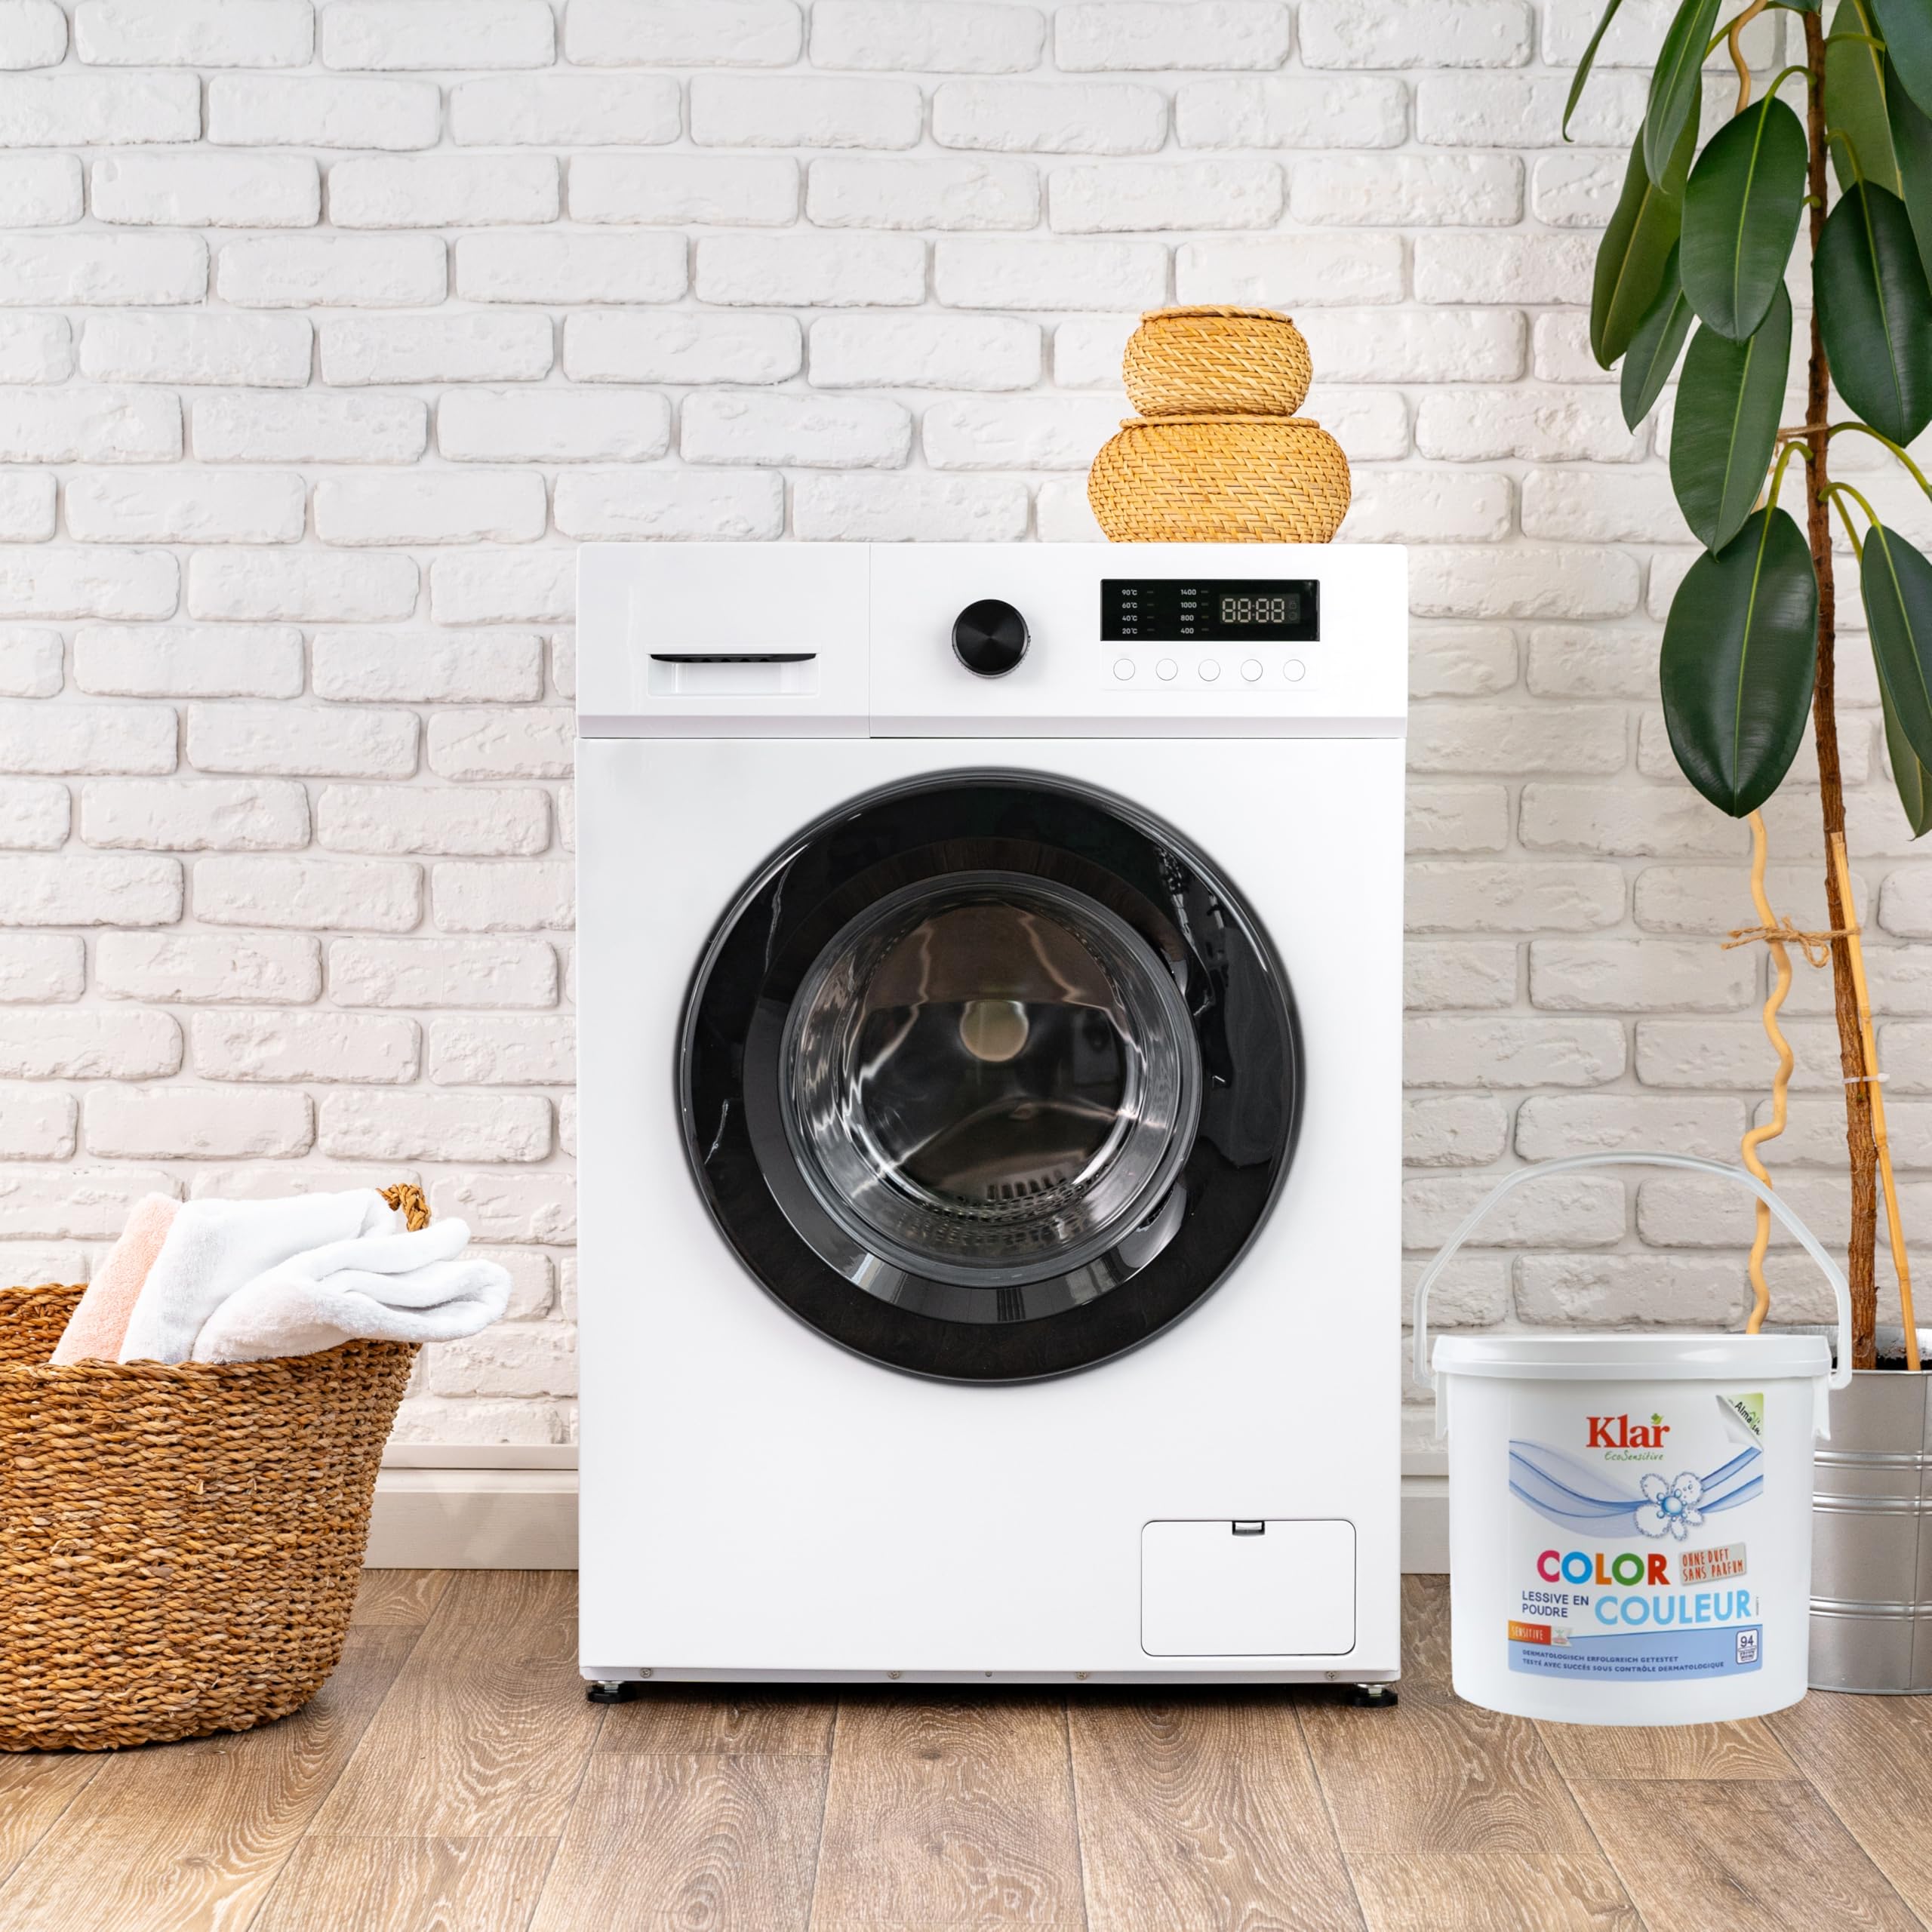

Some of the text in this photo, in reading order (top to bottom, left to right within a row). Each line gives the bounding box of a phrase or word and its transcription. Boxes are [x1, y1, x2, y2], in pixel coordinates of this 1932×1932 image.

[1586, 1414, 1670, 1448] Klar
[1604, 1450, 1663, 1461] EcoSensitive
[1682, 1548, 1729, 1567] OHNE DUFT
[1537, 1549, 1671, 1586] COLOR
[1683, 1560, 1743, 1582] SANS PARFUM
[1522, 1590, 1589, 1606] LESSIVE EN
[1522, 1603, 1568, 1618] POUDRE
[1595, 1589, 1752, 1625] COULEUR
[1512, 1626, 1543, 1640] SENSITIVE
[1740, 1635, 1754, 1647] 94
[1522, 1649, 1584, 1661] DERMATOLOGISCH
[1658, 1662, 1724, 1672] DERMATOLOGIQUE
